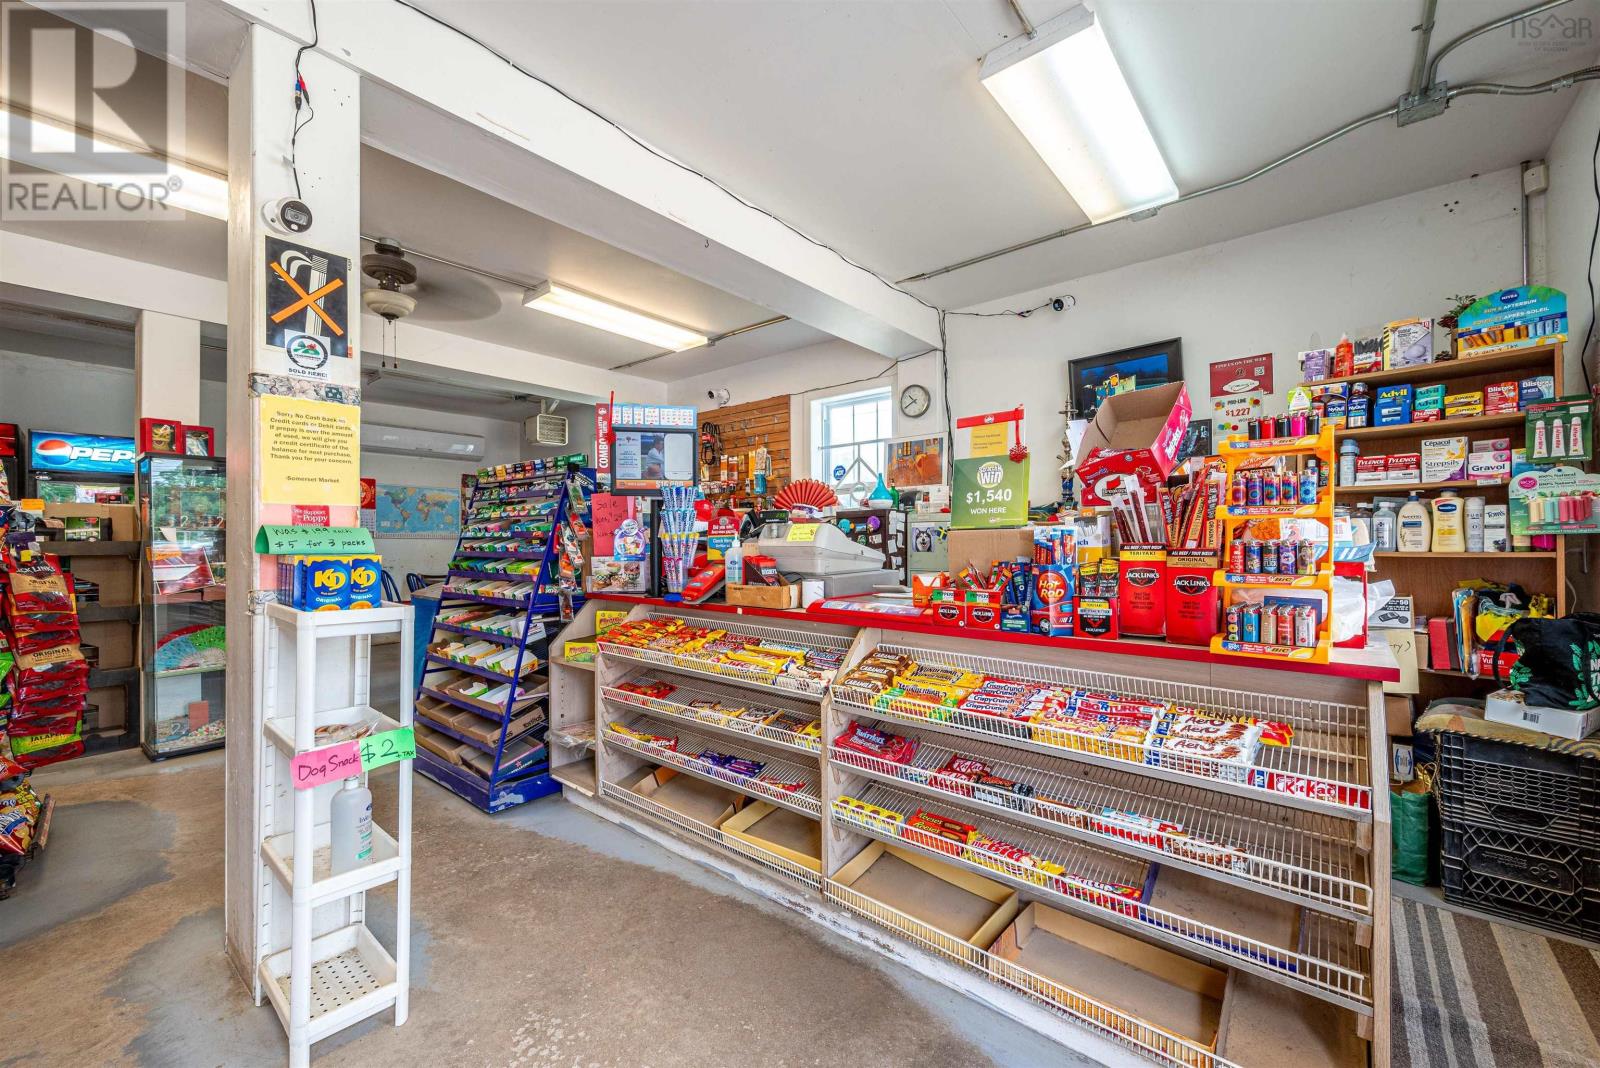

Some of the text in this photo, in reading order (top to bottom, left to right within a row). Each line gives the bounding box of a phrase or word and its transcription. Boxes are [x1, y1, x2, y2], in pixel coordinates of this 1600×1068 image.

[1504, 299, 1537, 309] AFTERSUN
[1380, 389, 1408, 399] Advil
[1425, 460, 1459, 468] Strepsils
[1472, 463, 1505, 472] Gravol
[980, 472, 1001, 485] Win
[966, 488, 1012, 504] $1,540
[328, 539, 336, 547] 3
[342, 540, 366, 549] packs
[314, 568, 346, 591] KD
[351, 566, 377, 589] KD
[1039, 579, 1061, 590] HOT
[1041, 589, 1064, 598] ROD
[33, 647, 71, 658] ORIGINAL
[860, 665, 890, 675] CARAMILK
[844, 679, 875, 689] CARAMILK
[1080, 700, 1140, 714] BIG TURK
[1180, 725, 1220, 734] Aero
[1174, 740, 1215, 752] Aero
[328, 753, 360, 772] Snack
[956, 760, 983, 773] KitKat
